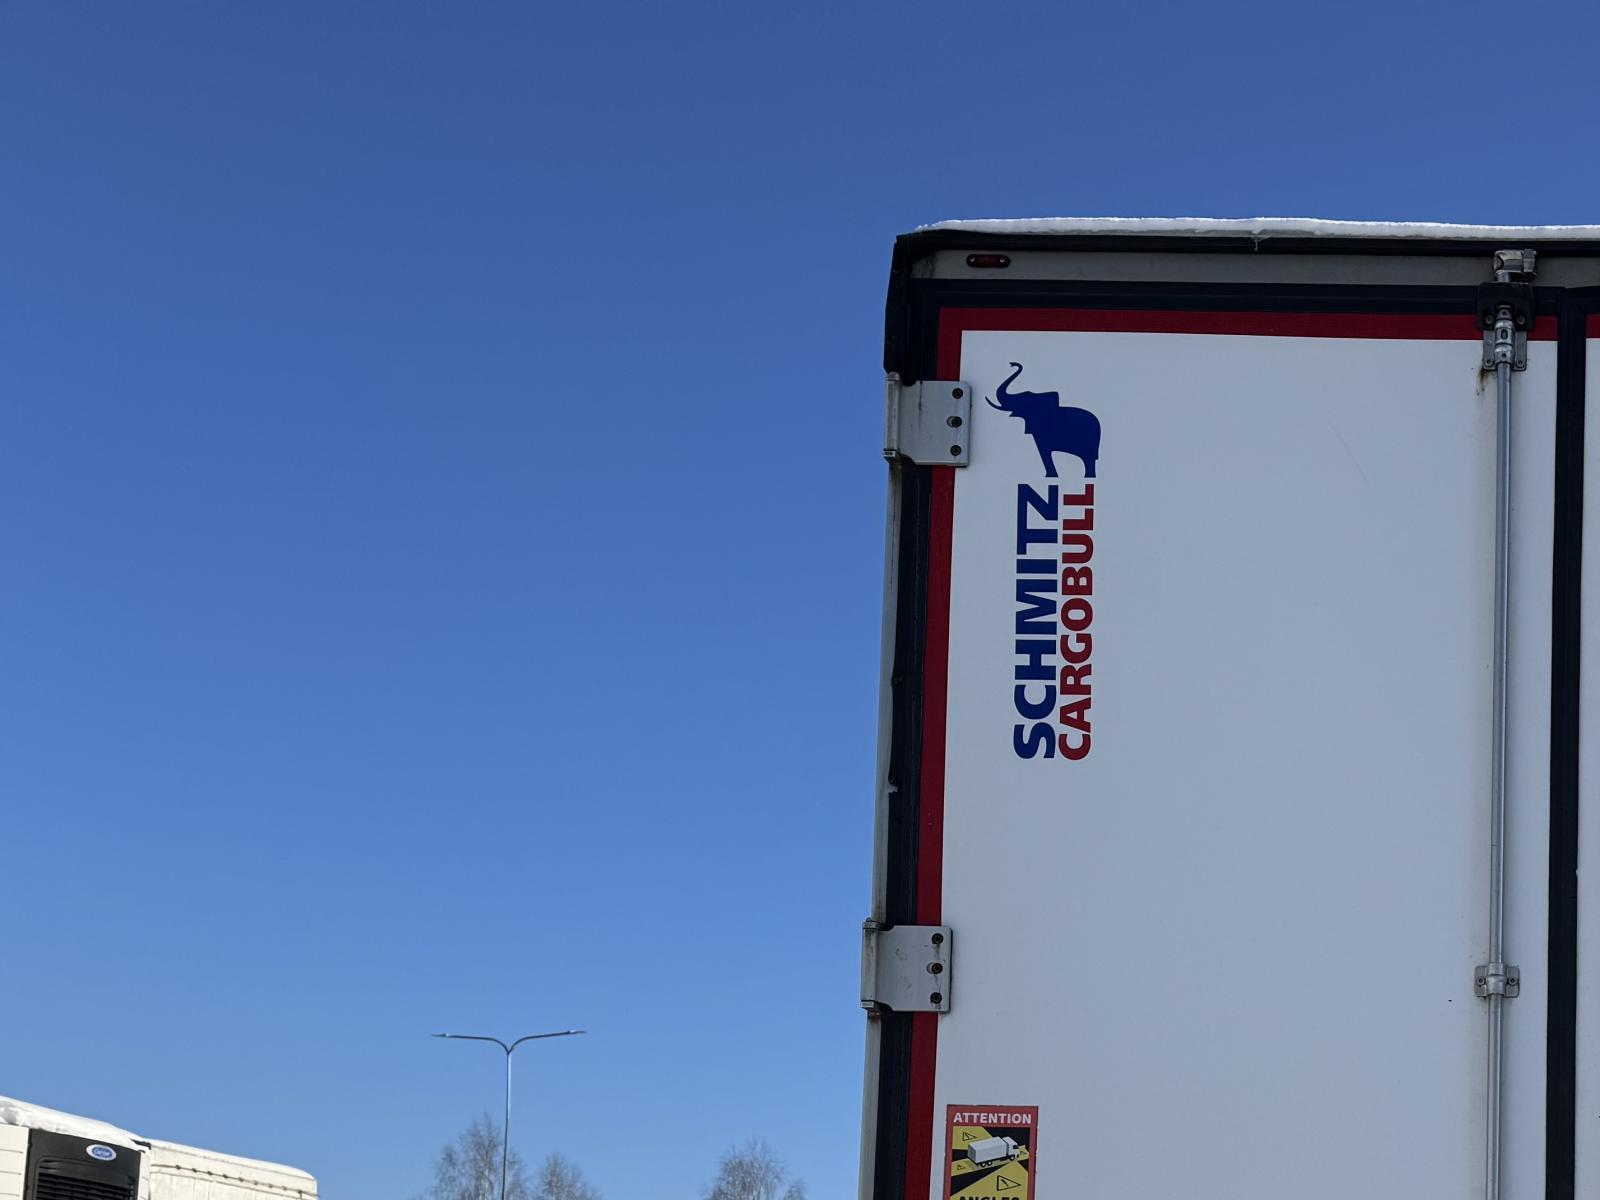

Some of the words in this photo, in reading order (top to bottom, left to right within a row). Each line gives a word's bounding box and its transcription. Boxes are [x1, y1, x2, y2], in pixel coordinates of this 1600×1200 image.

[1013, 483, 1059, 760] SCHMITZ
[1059, 483, 1095, 761] CARGOBULL
[953, 1111, 1032, 1125] ATTENTION
